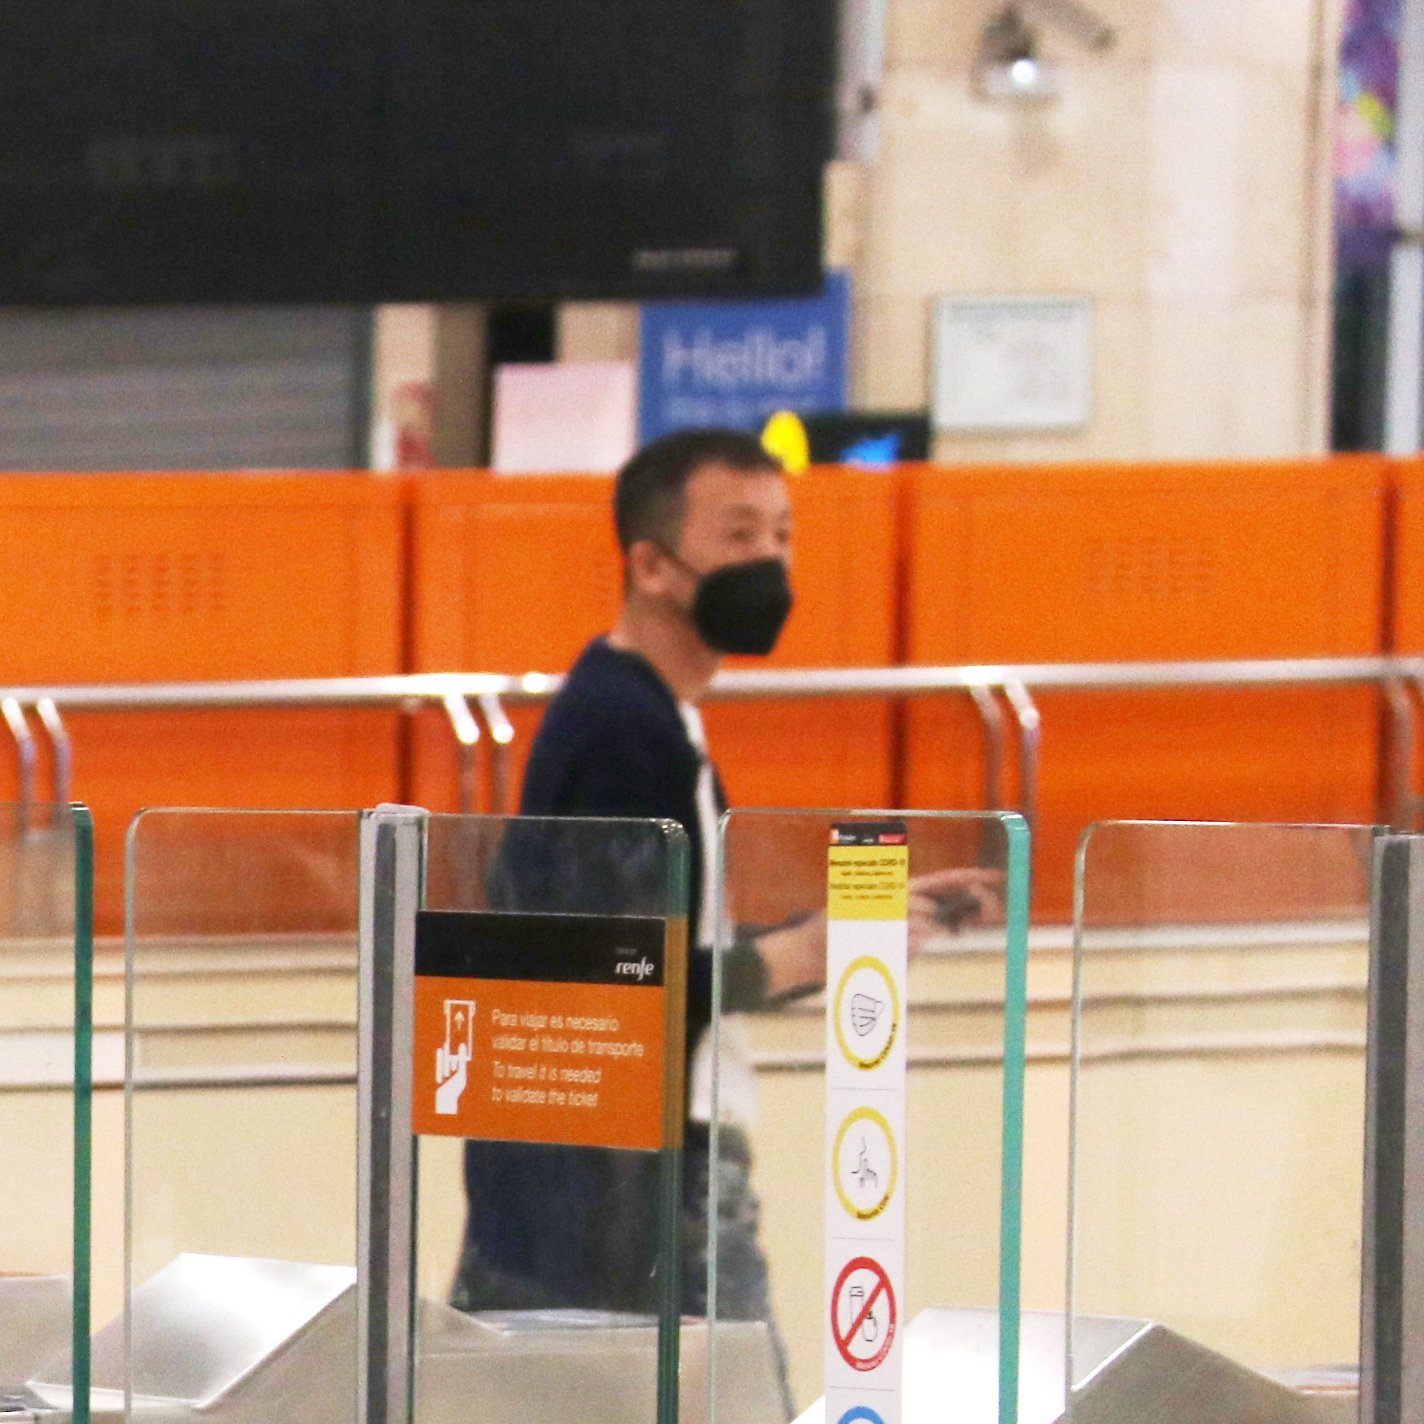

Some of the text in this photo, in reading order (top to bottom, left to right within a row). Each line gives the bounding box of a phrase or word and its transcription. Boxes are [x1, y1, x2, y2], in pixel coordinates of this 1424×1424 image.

[663, 324, 827, 386] Hello!
[615, 957, 654, 981] renfe
[491, 1008, 620, 1032] Para viajar es necesario
[492, 1036, 527, 1051] validar
[529, 1037, 539, 1052] el
[570, 1039, 585, 1053] de
[587, 1041, 644, 1059] transporte
[493, 1061, 505, 1078] To
[507, 1064, 537, 1079] travel
[560, 1067, 602, 1084] needed
[505, 1086, 547, 1103] validate
